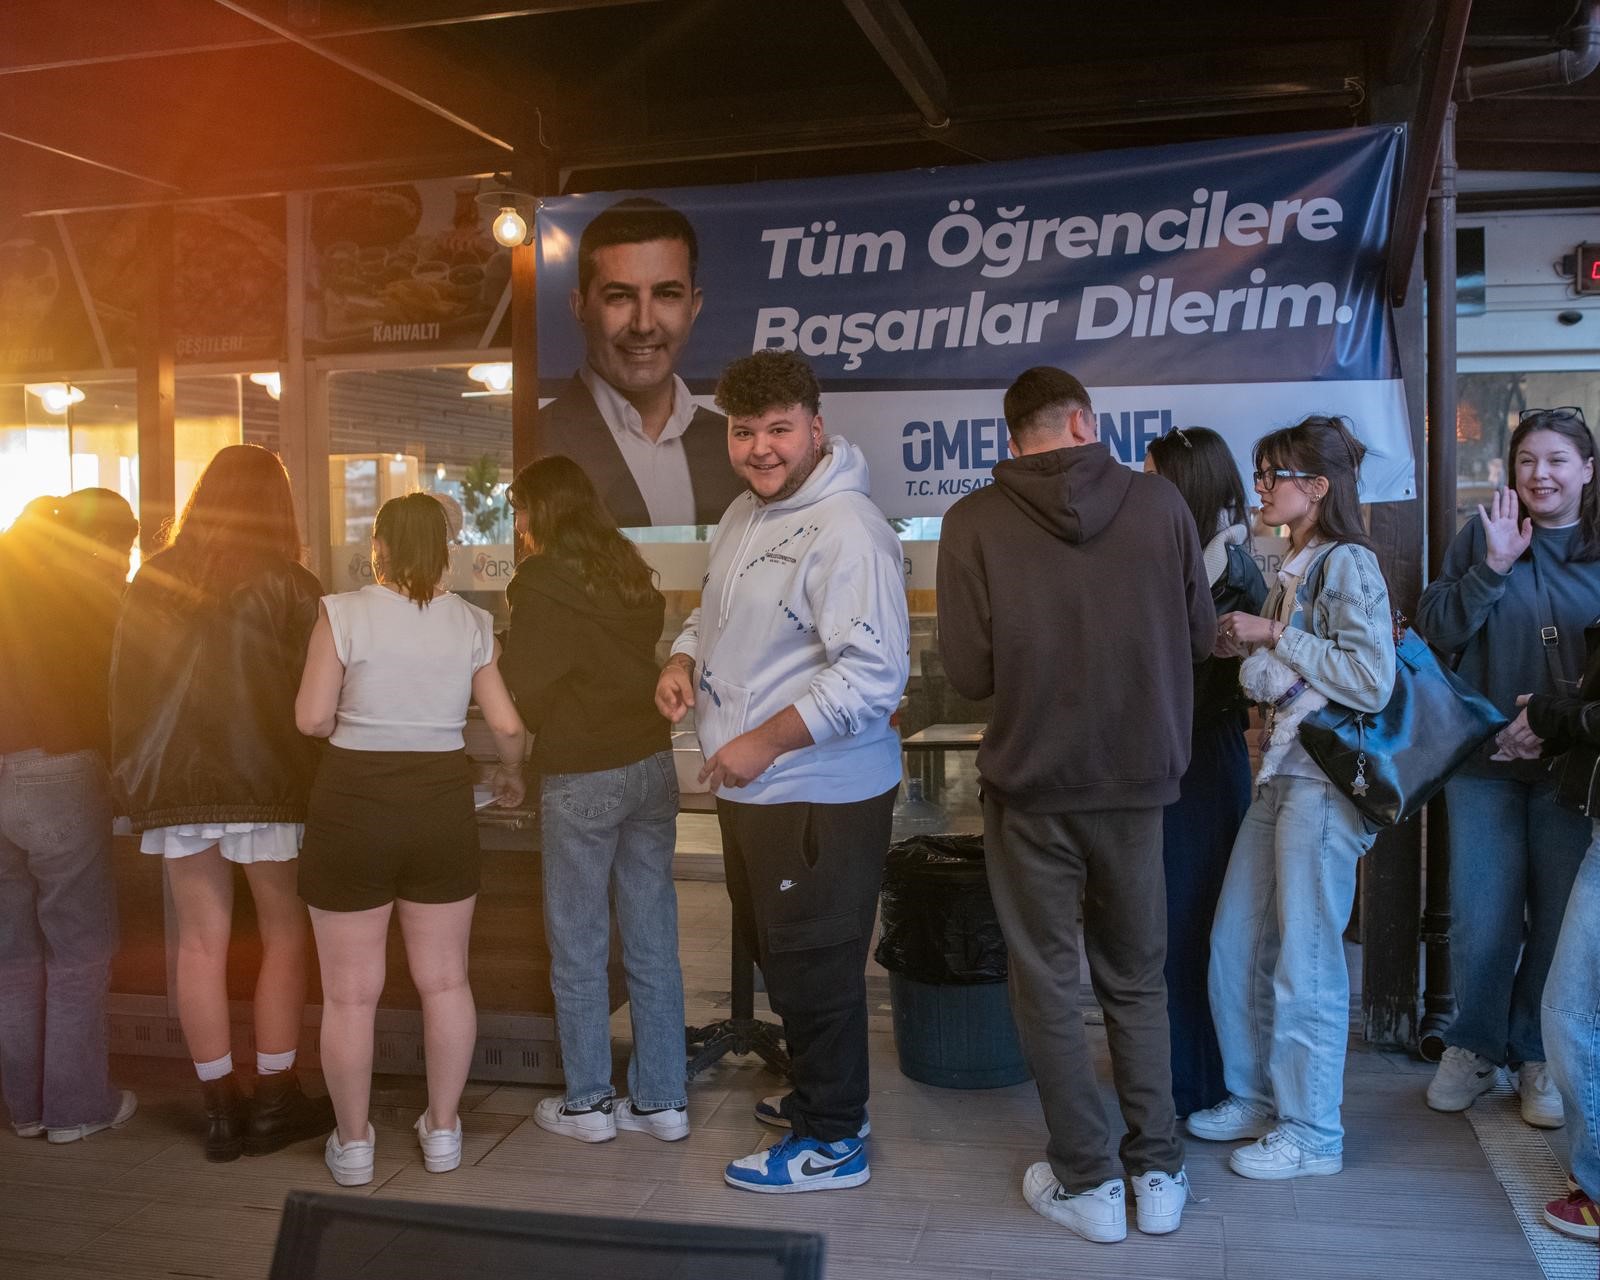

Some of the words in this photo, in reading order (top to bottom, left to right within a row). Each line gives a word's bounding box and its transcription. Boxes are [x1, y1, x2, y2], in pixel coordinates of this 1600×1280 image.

[761, 220, 906, 279] Tüm
[928, 188, 1343, 278] Öğrencilere
[373, 322, 440, 342] KAHVALTI
[752, 290, 1059, 371] Başarılar
[1075, 268, 1353, 341] Dilerim.
[905, 480, 933, 496] T.C.
